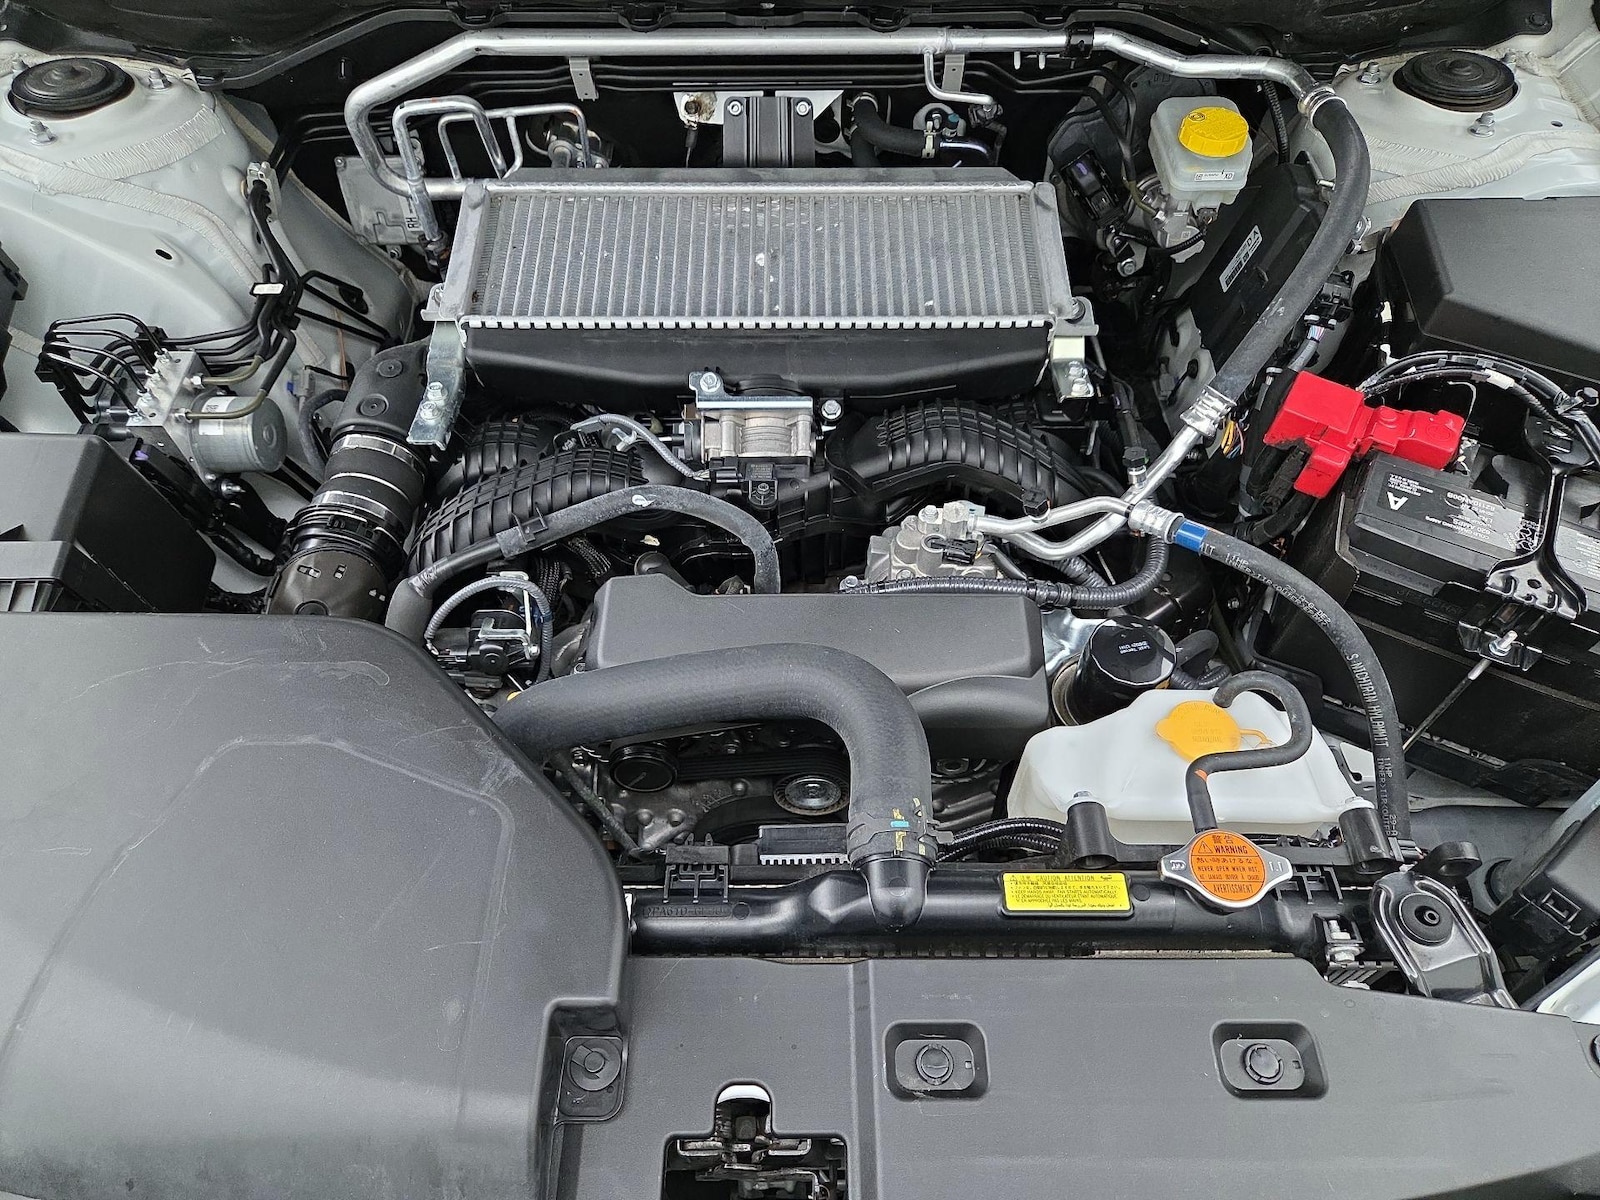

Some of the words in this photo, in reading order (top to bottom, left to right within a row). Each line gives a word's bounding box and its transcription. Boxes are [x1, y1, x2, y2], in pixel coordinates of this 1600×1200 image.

[406, 217, 419, 228] RH
[1388, 491, 1408, 511] A
[1214, 845, 1248, 855] WARNING
